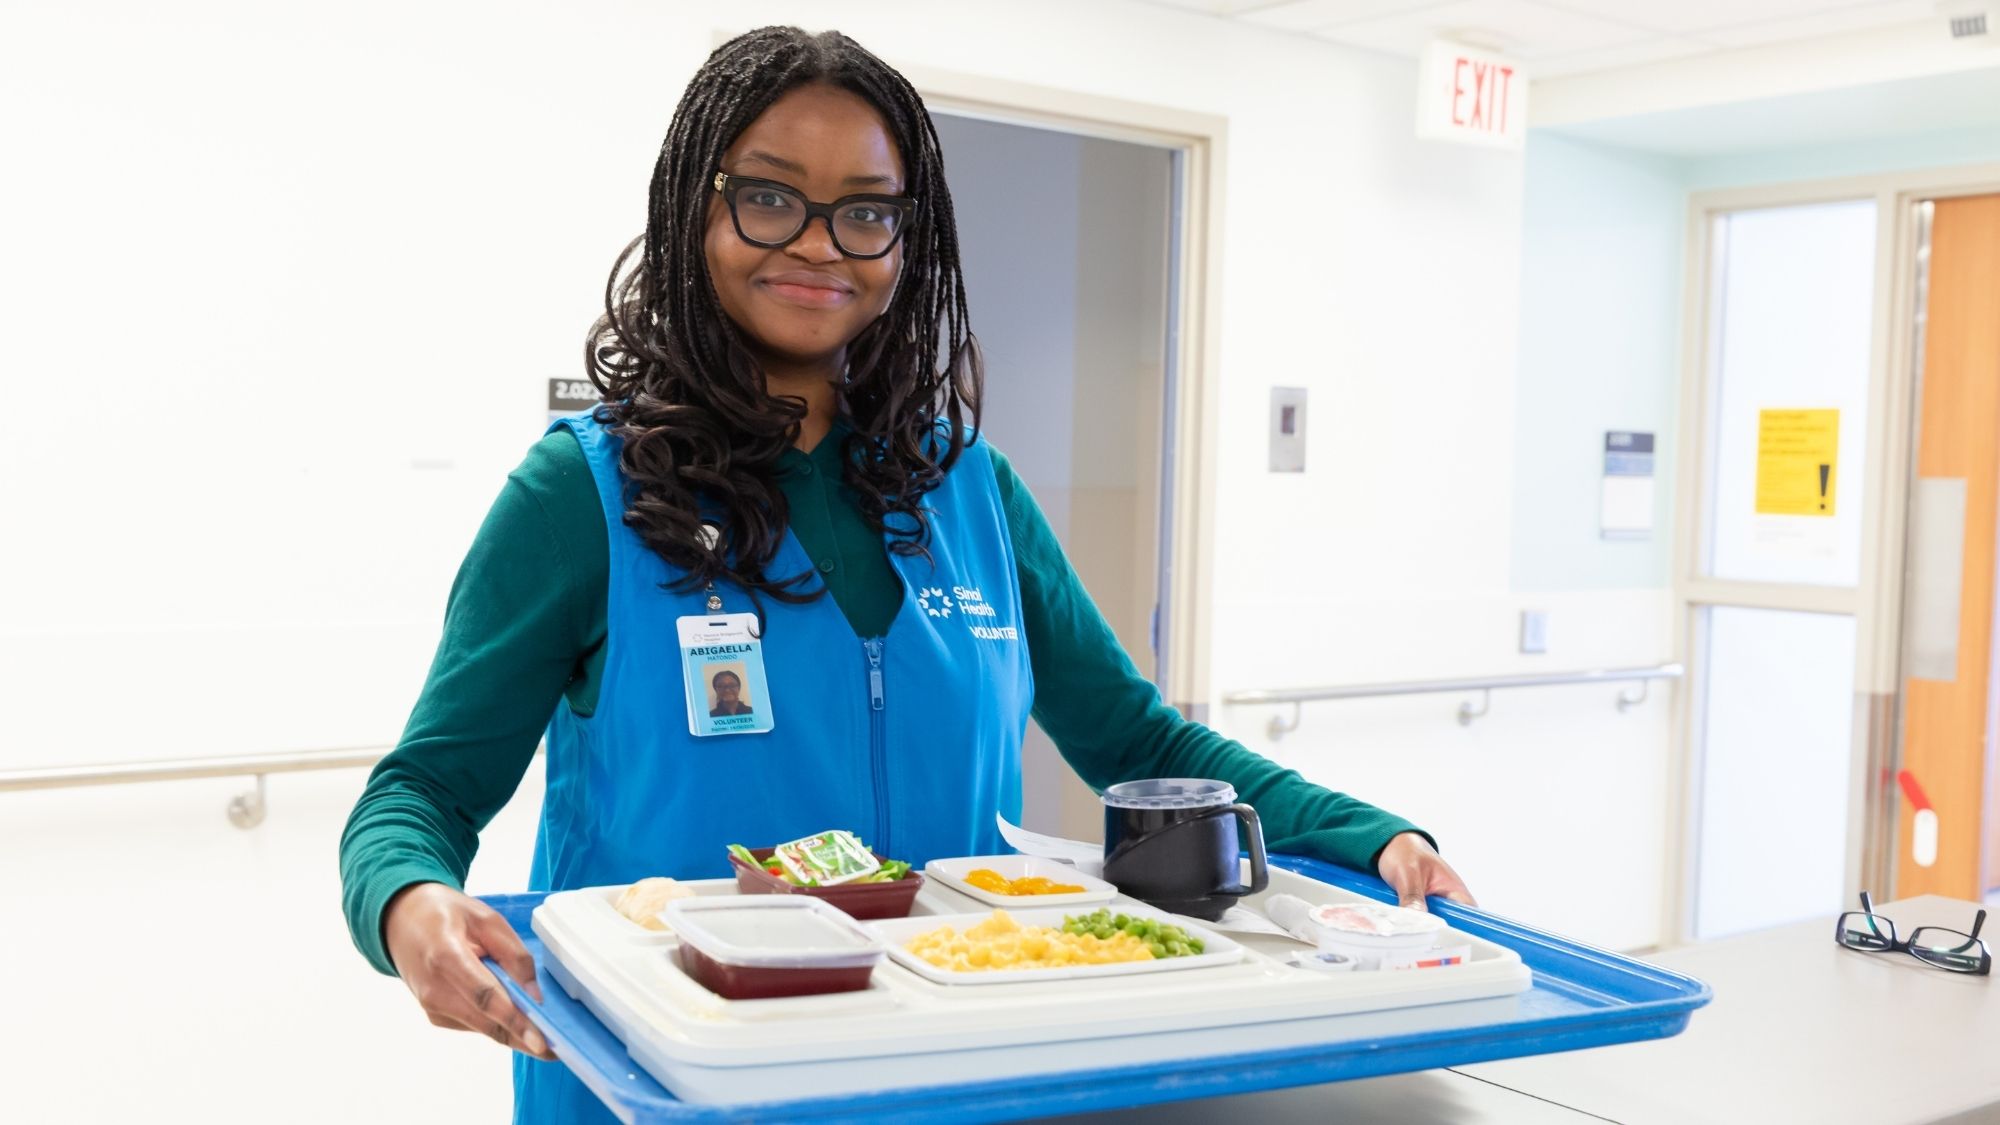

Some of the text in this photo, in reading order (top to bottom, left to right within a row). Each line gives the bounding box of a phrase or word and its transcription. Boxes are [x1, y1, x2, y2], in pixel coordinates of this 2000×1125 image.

[1452, 58, 1513, 134] EXIT
[953, 586, 983, 601] Sinai
[958, 601, 996, 617] Health
[690, 644, 753, 656] ABIGAELLA
[713, 717, 754, 726] VOLUNTEER
